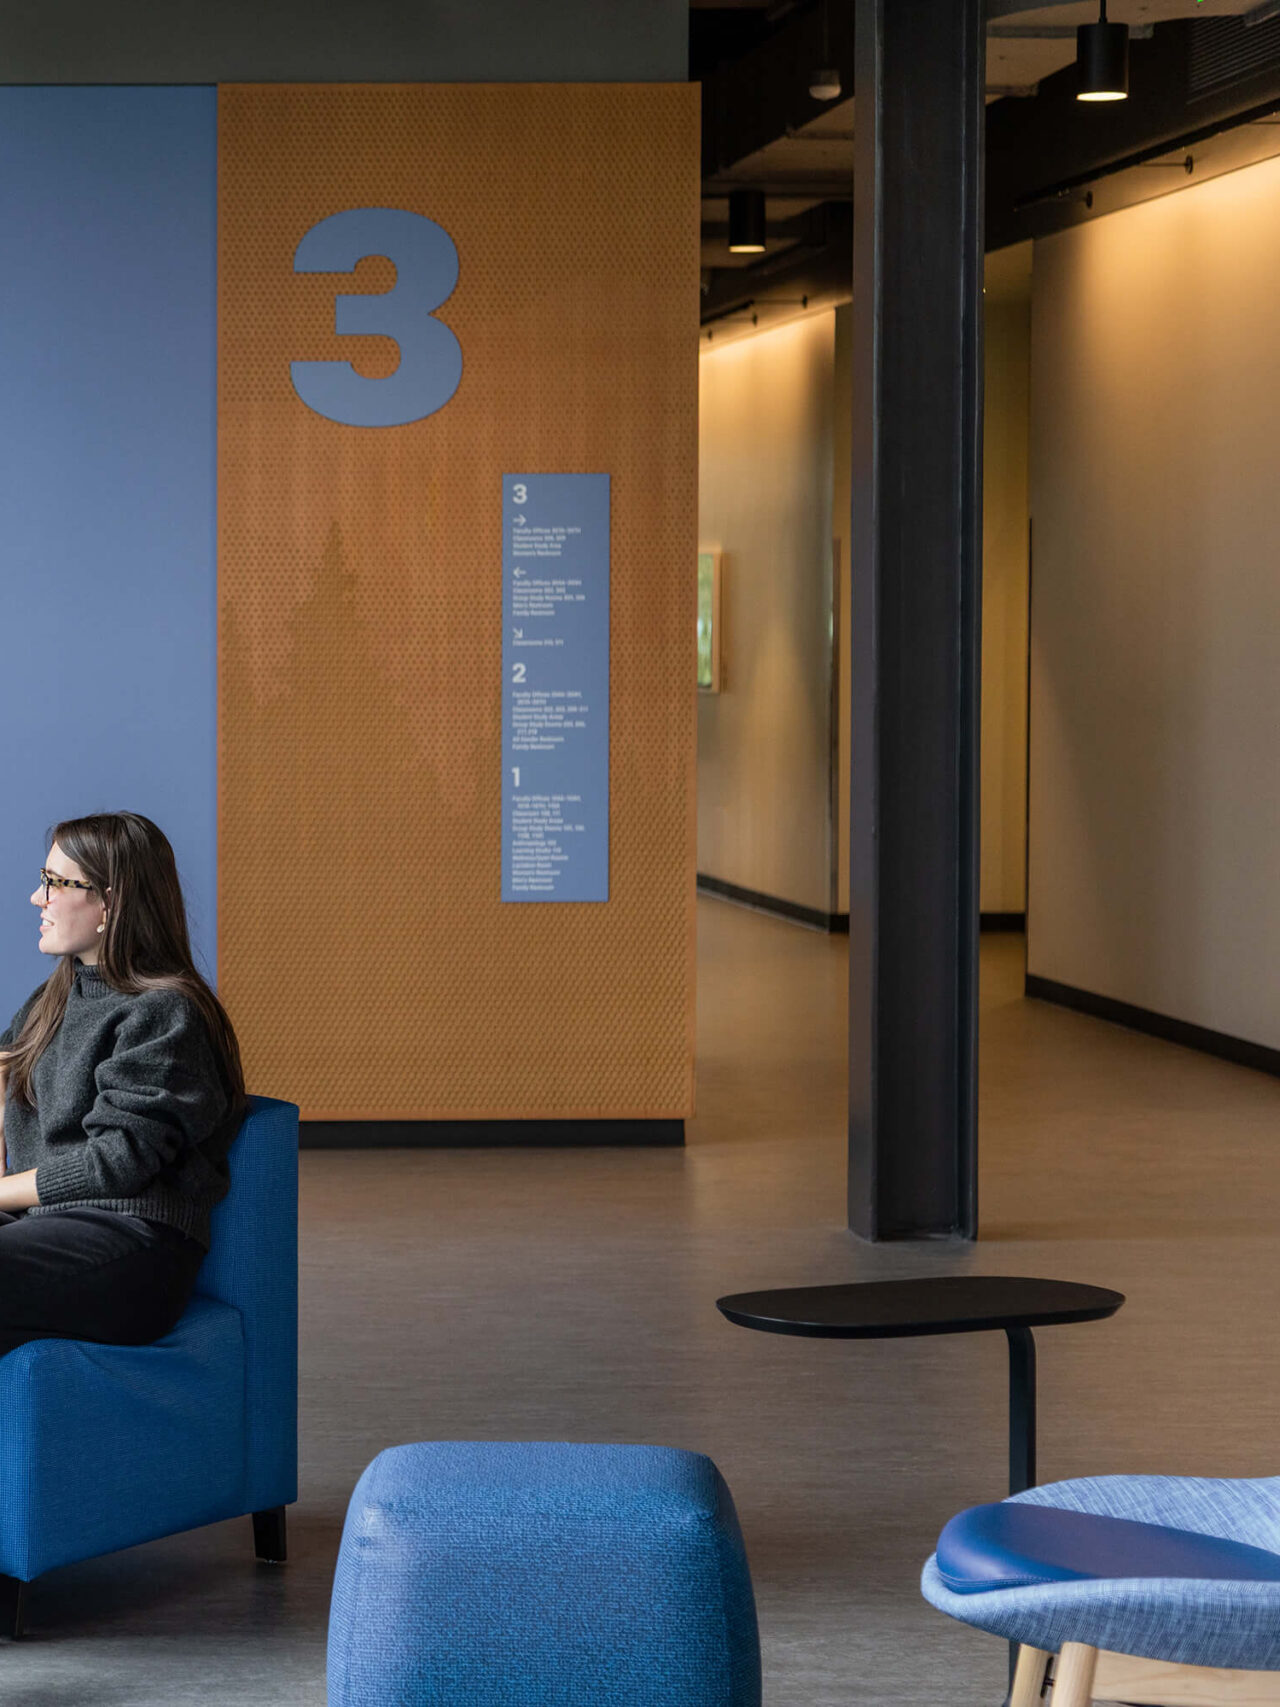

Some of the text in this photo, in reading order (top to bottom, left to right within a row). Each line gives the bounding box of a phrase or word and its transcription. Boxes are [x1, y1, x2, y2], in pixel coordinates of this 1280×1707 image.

[290, 207, 464, 428] 3
[512, 483, 528, 505] 3
[512, 663, 526, 683] 2
[512, 767, 520, 787] 1
